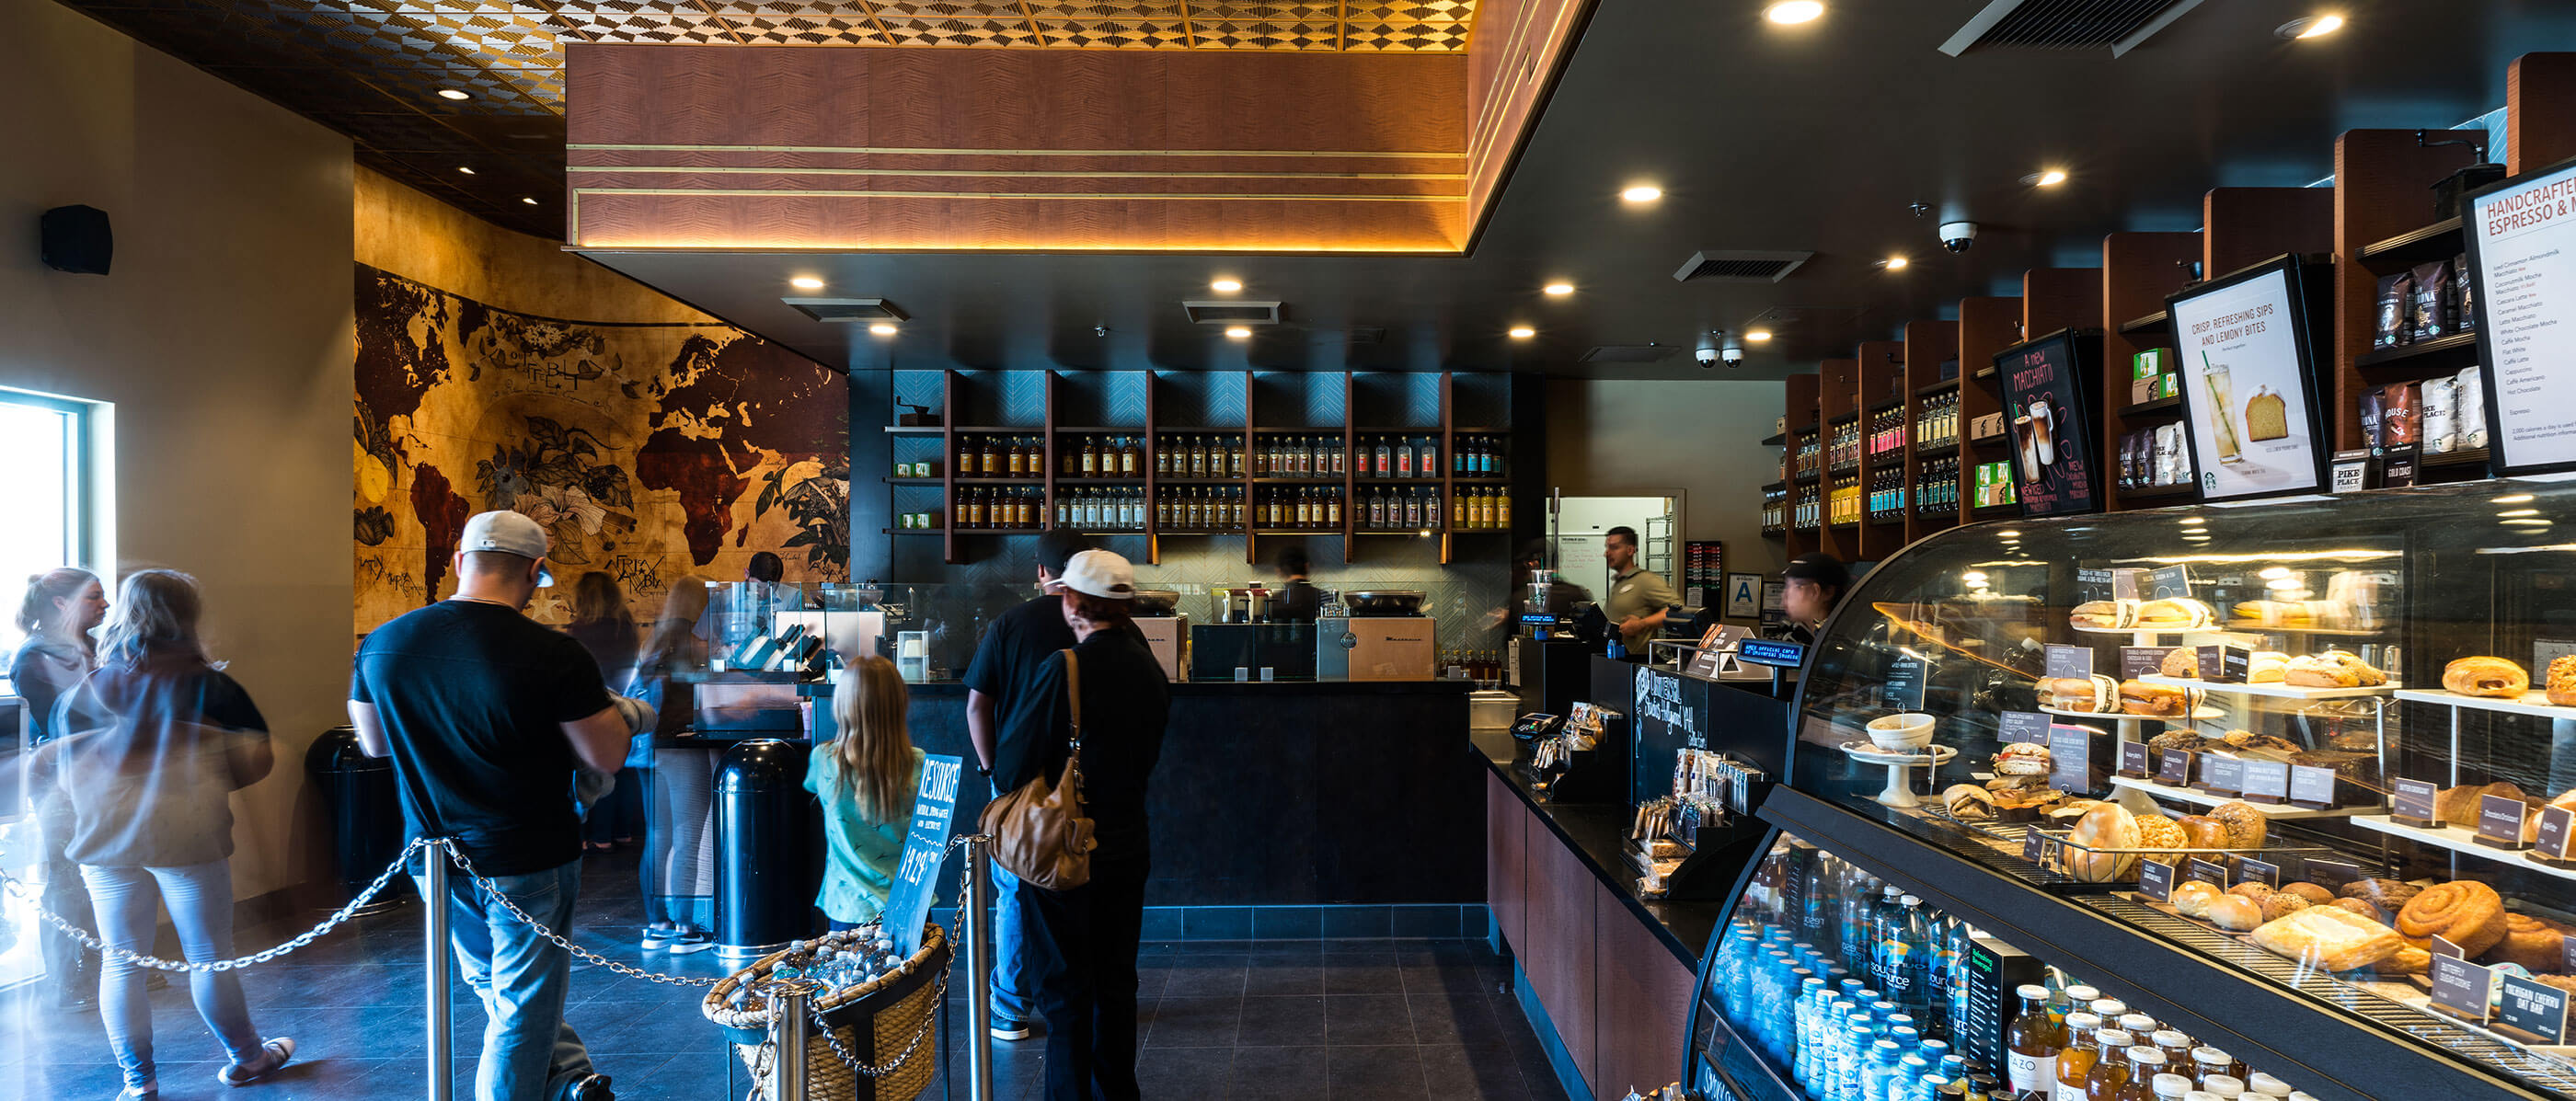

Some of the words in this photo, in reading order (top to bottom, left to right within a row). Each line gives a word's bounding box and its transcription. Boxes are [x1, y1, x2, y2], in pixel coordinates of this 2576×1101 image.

[2487, 177, 2576, 219] HANDCRAFTE
[2489, 203, 2553, 236] ESPRESSO
[2558, 200, 2567, 216] &
[2191, 321, 2212, 335] CRISP,
[2213, 309, 2255, 329] REFRESHING
[2256, 304, 2274, 318] SIPS
[2202, 334, 2214, 346] AND
[2216, 328, 2243, 344] LEMONY
[2245, 321, 2266, 336] BITES
[2338, 469, 2359, 478] PIKE
[1735, 581, 1753, 602] A
[919, 758, 960, 803] RESOURCE
[2505, 983, 2533, 1001] MICHIGAN
[2535, 992, 2560, 1009] CHERRY
[2517, 999, 2529, 1010] OAT
[2530, 1003, 2545, 1015] BAR
